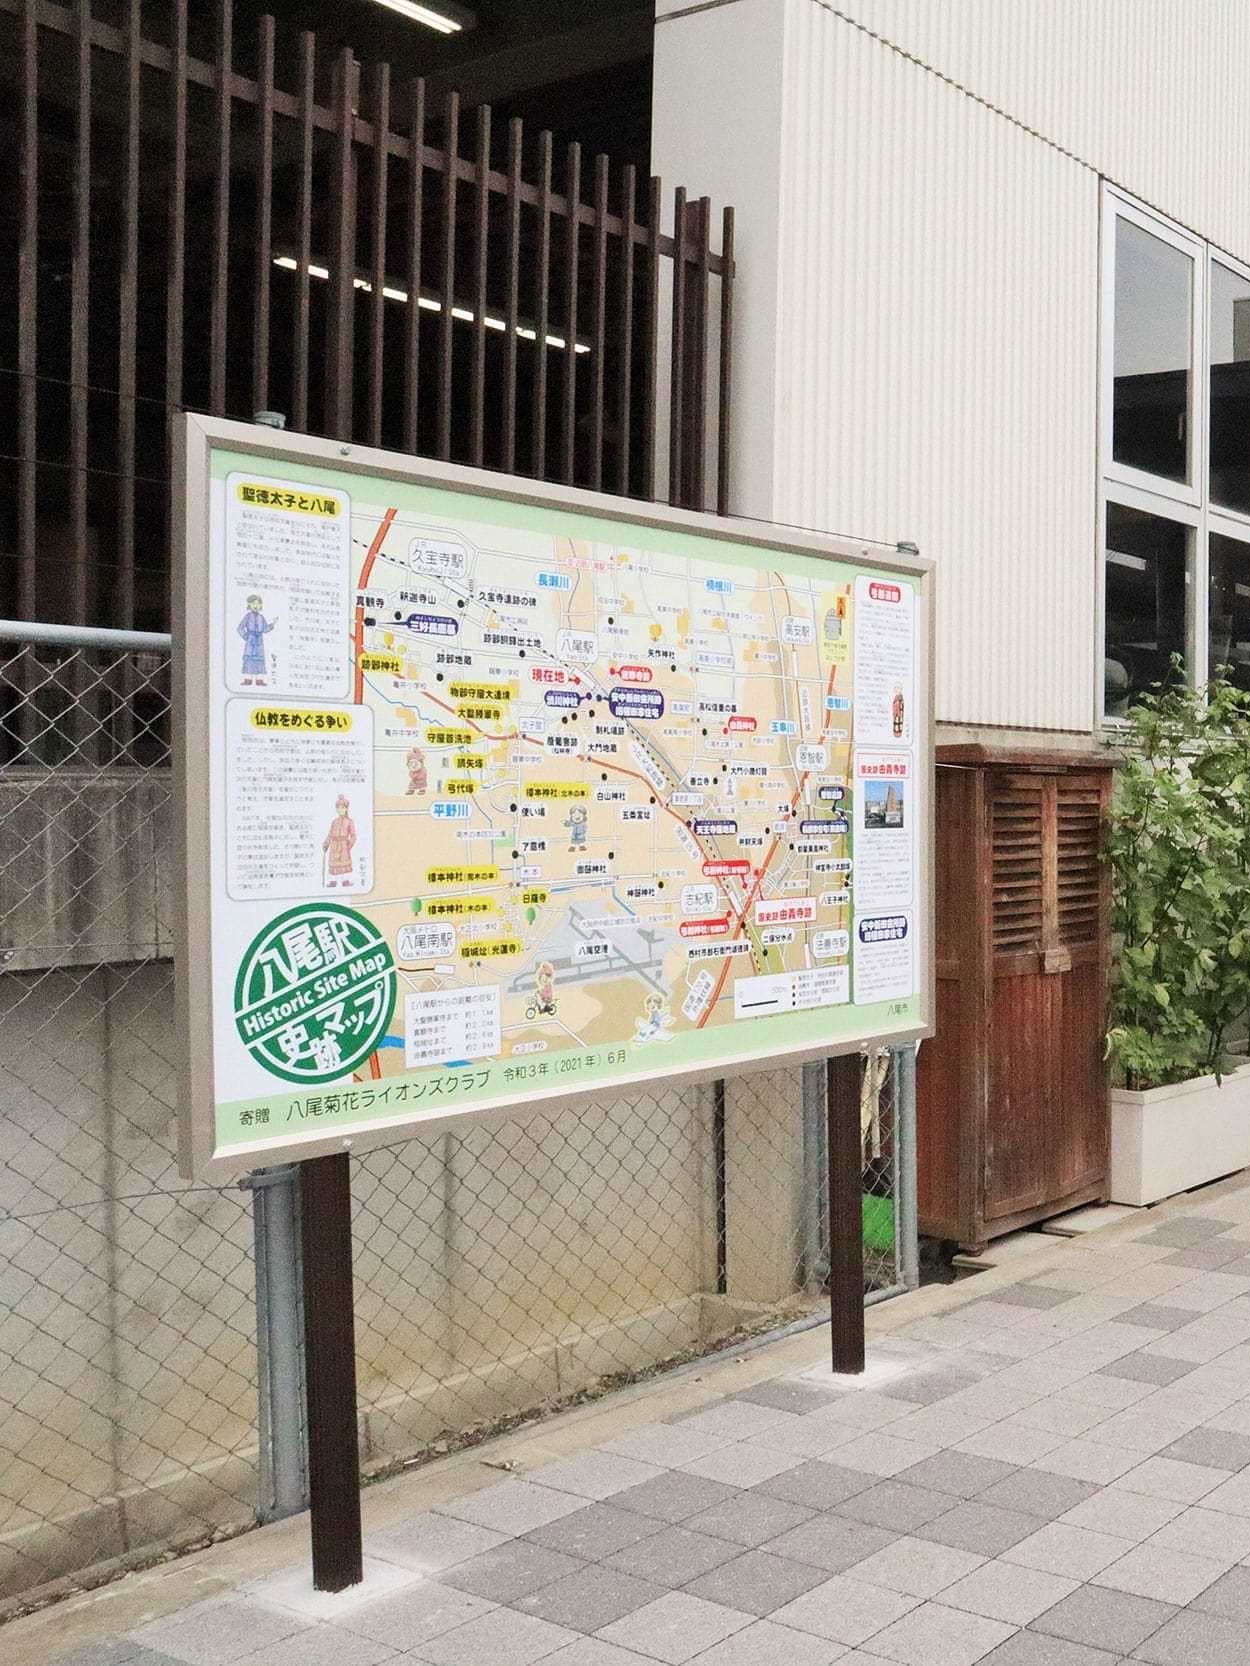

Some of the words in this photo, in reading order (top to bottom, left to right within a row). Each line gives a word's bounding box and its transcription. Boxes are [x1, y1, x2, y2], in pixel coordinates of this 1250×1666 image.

[242, 487, 336, 515] 聖徳太子と八尾
[411, 549, 464, 569] 久宝寺駅
[538, 574, 570, 589] 長瀬川
[561, 638, 594, 654] 八尾駅
[532, 668, 565, 684] 現在地
[254, 711, 348, 729] 仏教をめぐる争い
[433, 803, 470, 818] 平野川
[401, 931, 454, 950] 八尾南駅
[258, 918, 361, 999] 八尾駅
[243, 987, 315, 1037] Historic
[312, 972, 349, 1001] Site
[350, 952, 388, 980] Map
[886, 1003, 910, 1017] 八尾市
[238, 1107, 271, 1127] 寄贈
[285, 1070, 492, 1123] 八尾菊花ライオンズクラブ
